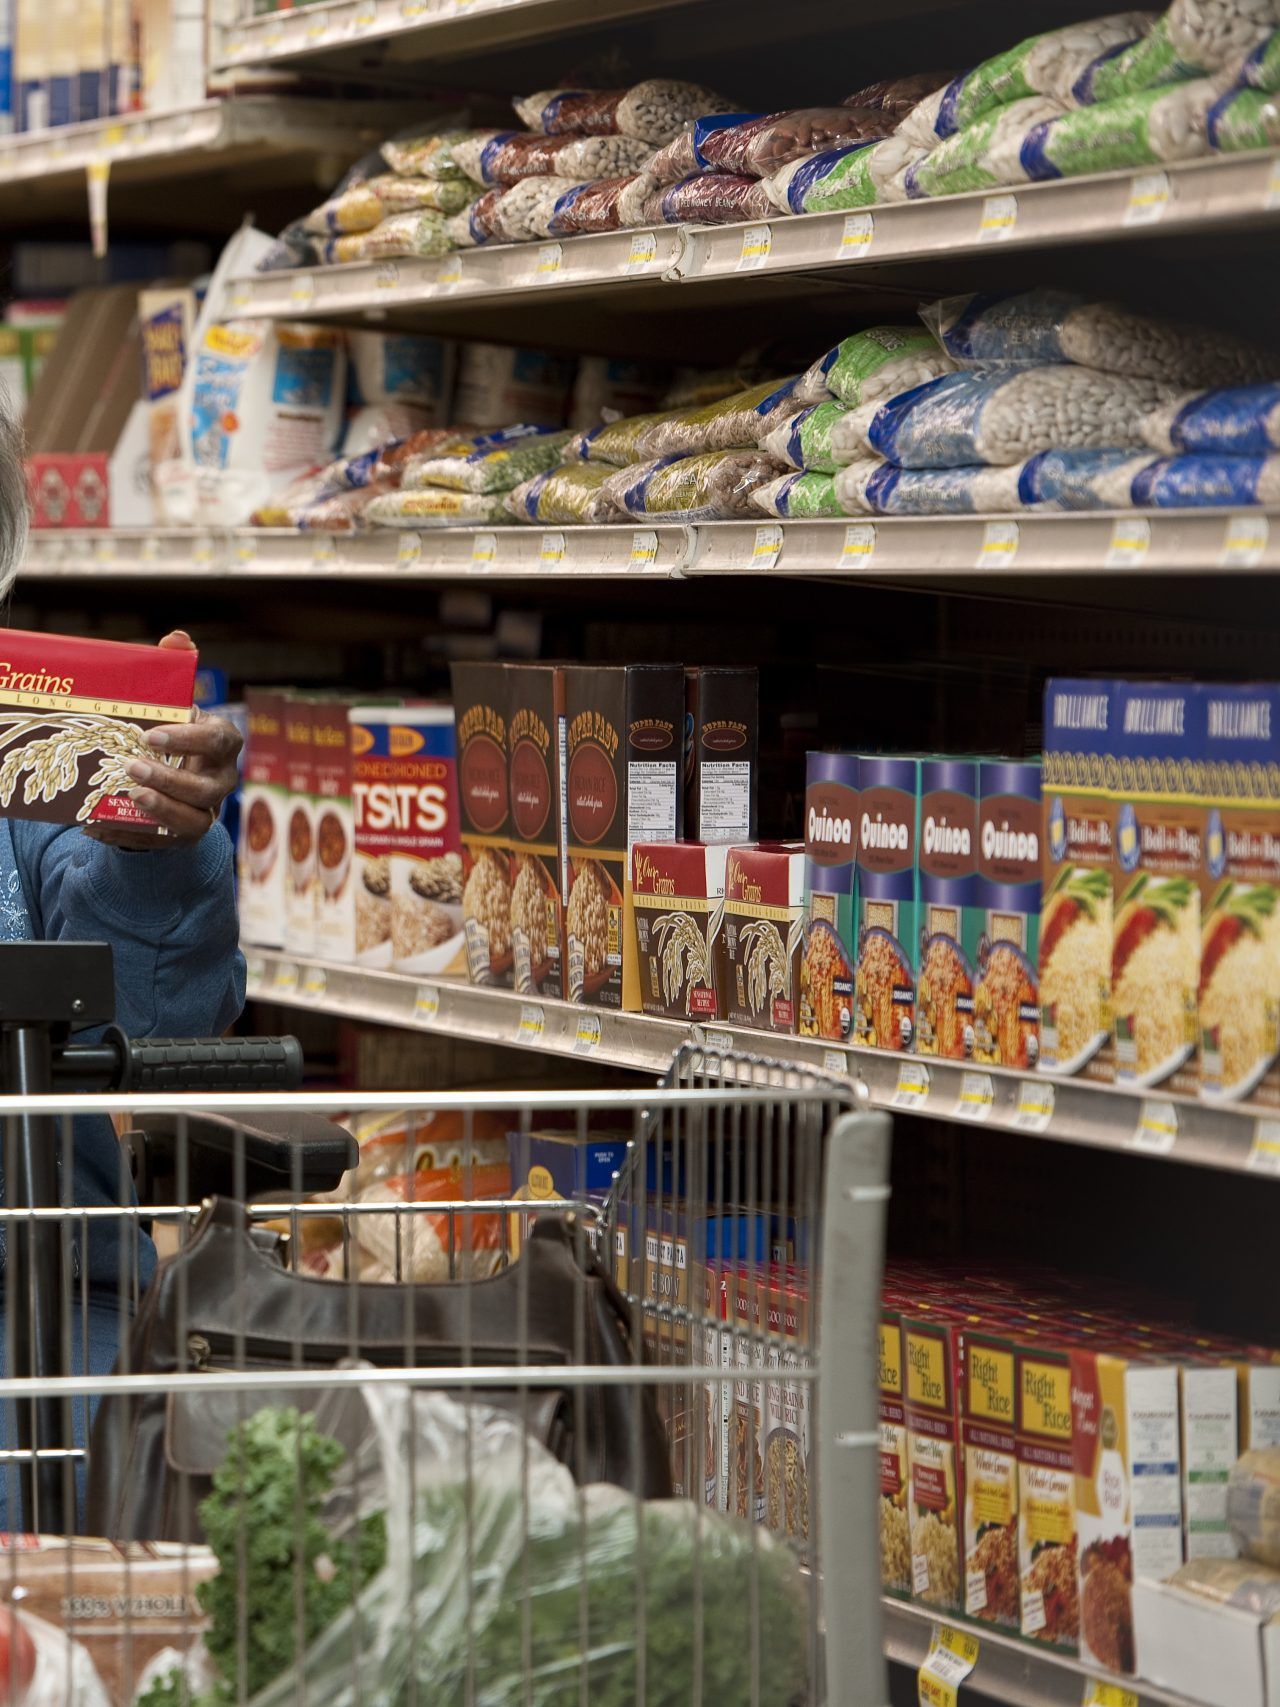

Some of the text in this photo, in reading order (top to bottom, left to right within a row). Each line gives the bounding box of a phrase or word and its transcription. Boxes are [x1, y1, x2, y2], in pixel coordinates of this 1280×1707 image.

[17, 691, 72, 708] LONG
[94, 702, 163, 718] GRAIN
[108, 798, 135, 808] SENSA
[117, 807, 144, 818] RECIP
[808, 806, 852, 844] Quinoa
[861, 812, 908, 850] Quinoa
[924, 816, 970, 855] Quinoa
[982, 820, 1038, 862] Quinoa
[642, 856, 654, 880] Our
[734, 861, 745, 884] Our
[652, 872, 675, 896] Grains
[742, 878, 762, 902] Grains
[667, 1245, 684, 1264] PATA
[908, 1342, 930, 1375] Right
[972, 1354, 998, 1388] Right
[922, 1372, 942, 1400] Rice
[1025, 1370, 1056, 1404] Right
[988, 1387, 1011, 1415] Rice
[1044, 1402, 1070, 1431] Rice
